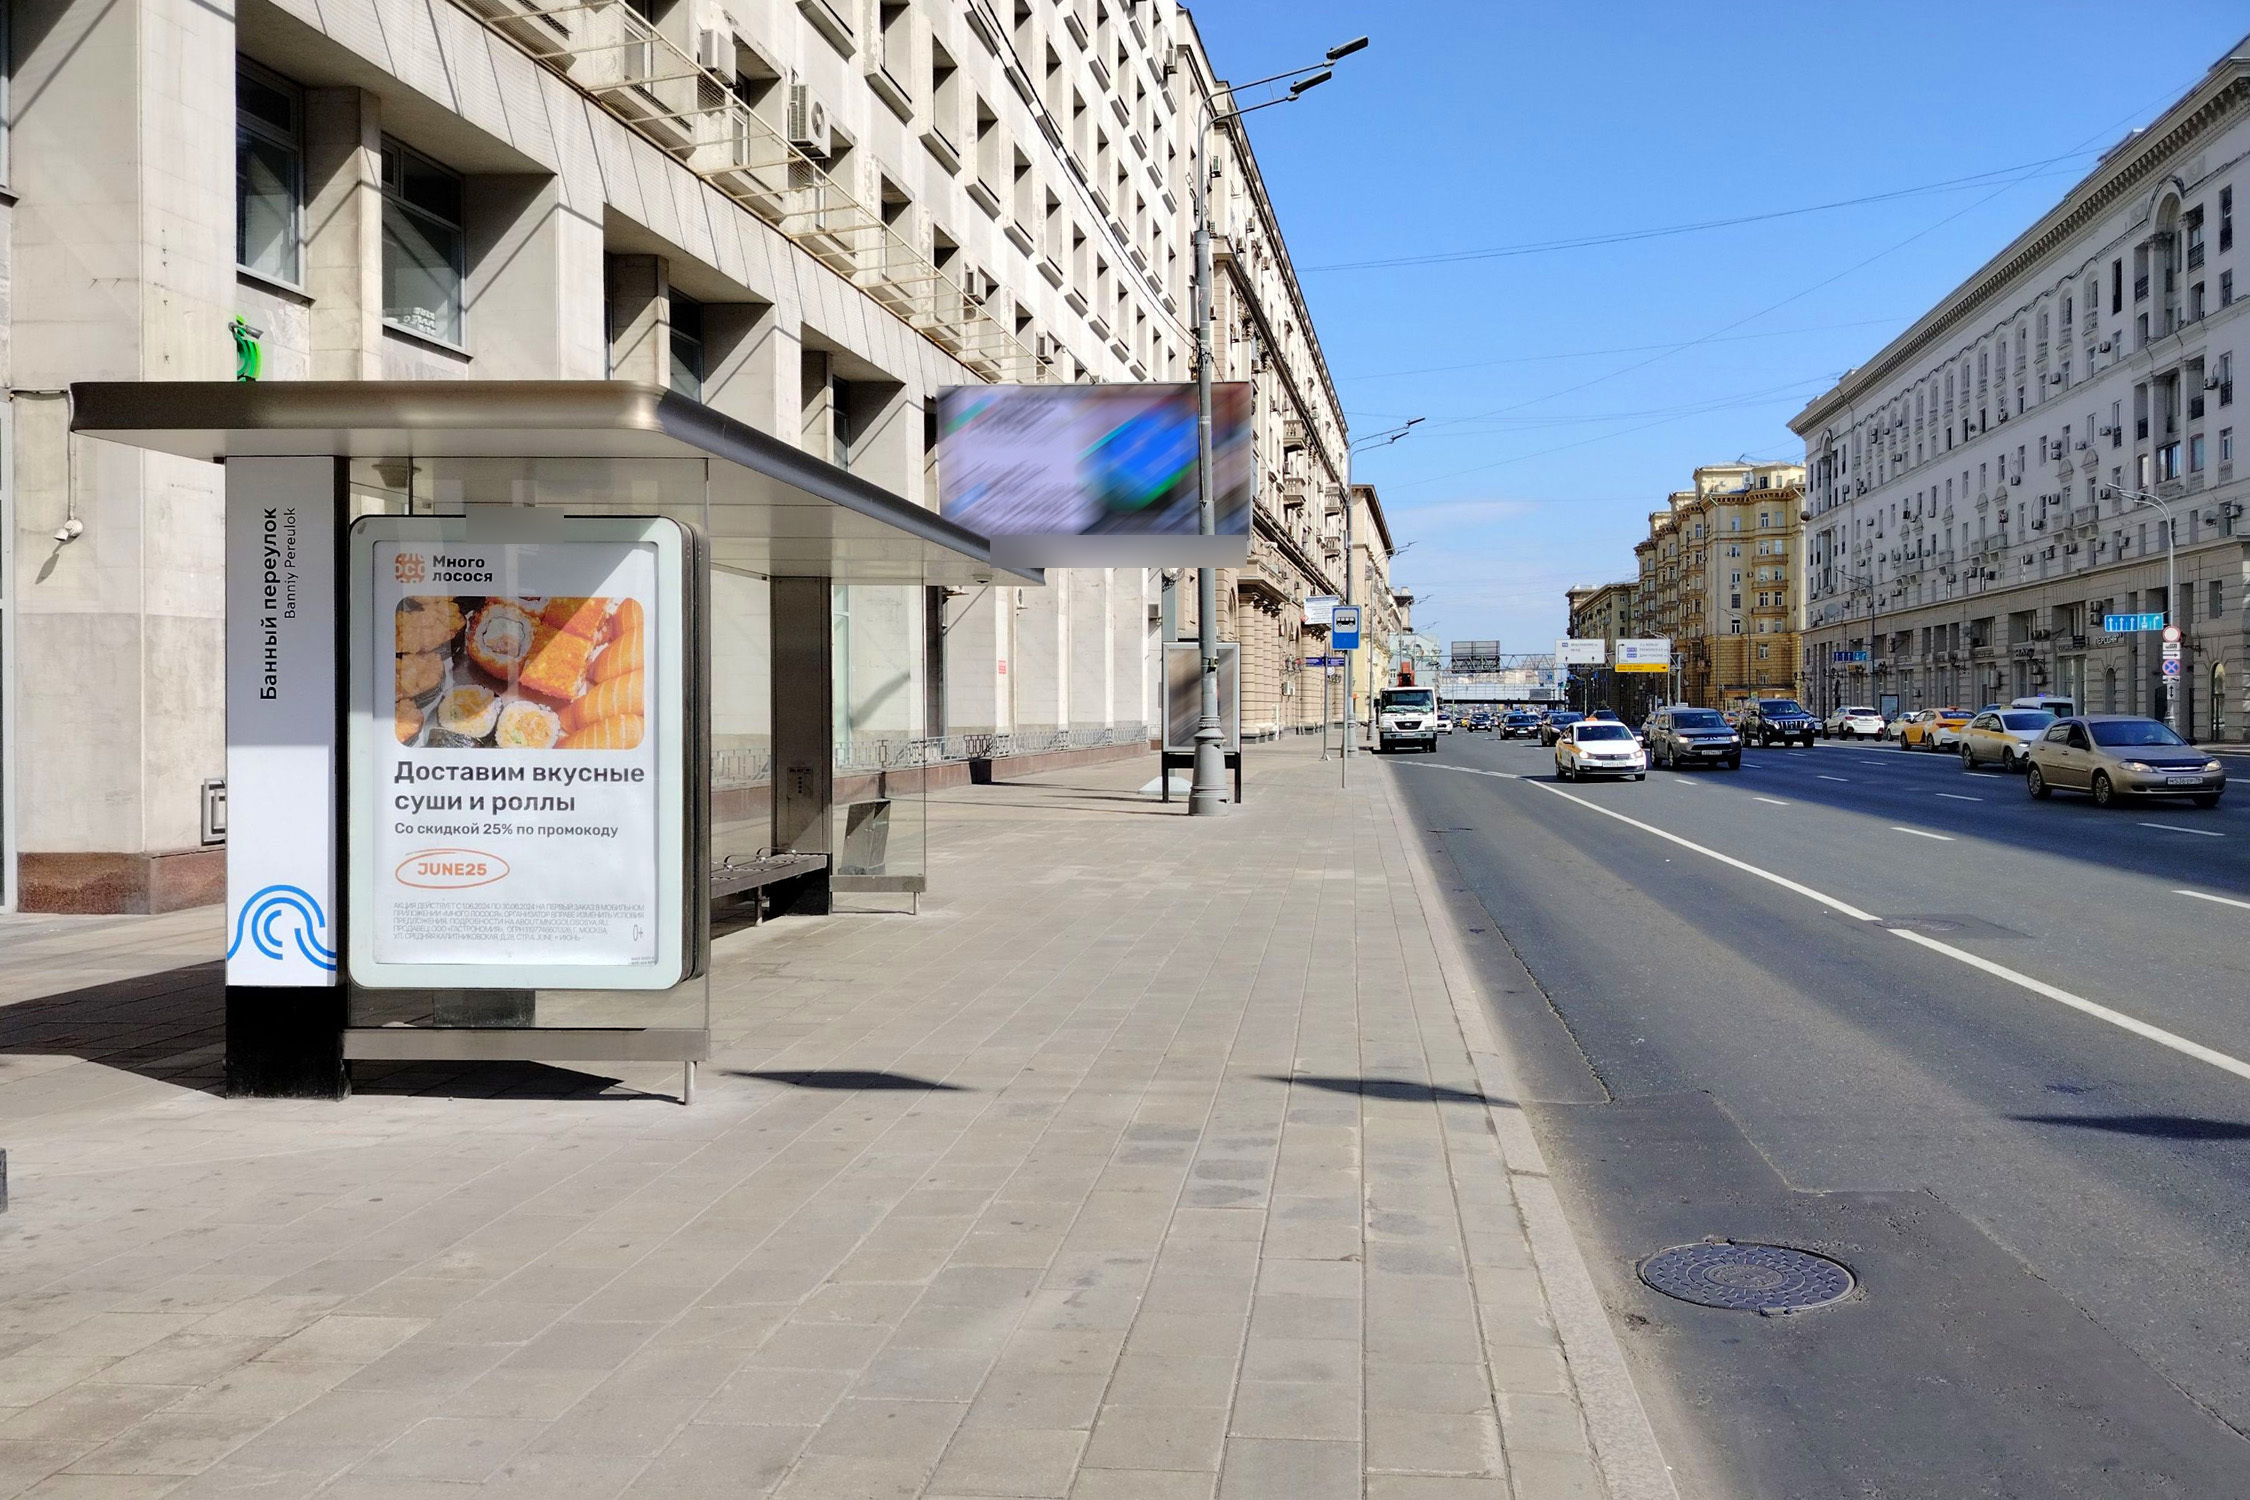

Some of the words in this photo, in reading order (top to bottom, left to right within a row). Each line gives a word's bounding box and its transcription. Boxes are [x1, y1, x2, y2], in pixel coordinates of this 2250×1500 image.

[284, 508, 296, 567] Pereulok
[264, 508, 280, 609] переулок
[433, 555, 485, 568] Много
[432, 572, 493, 582] лосося
[285, 572, 298, 619] Banniy
[260, 617, 277, 700] Банный
[394, 761, 525, 784] Доставим
[532, 766, 645, 786] вкусные
[394, 795, 462, 814] суши
[469, 796, 485, 810] и
[492, 795, 575, 815] роллы
[395, 822, 414, 835] Со
[417, 823, 480, 836] скидкой
[483, 823, 513, 836] 25%
[516, 826, 534, 836] по
[538, 826, 618, 838] промокоду
[417, 862, 488, 877] JUNE25
[536, 903, 545, 911] НА
[633, 924, 644, 942] 0+
